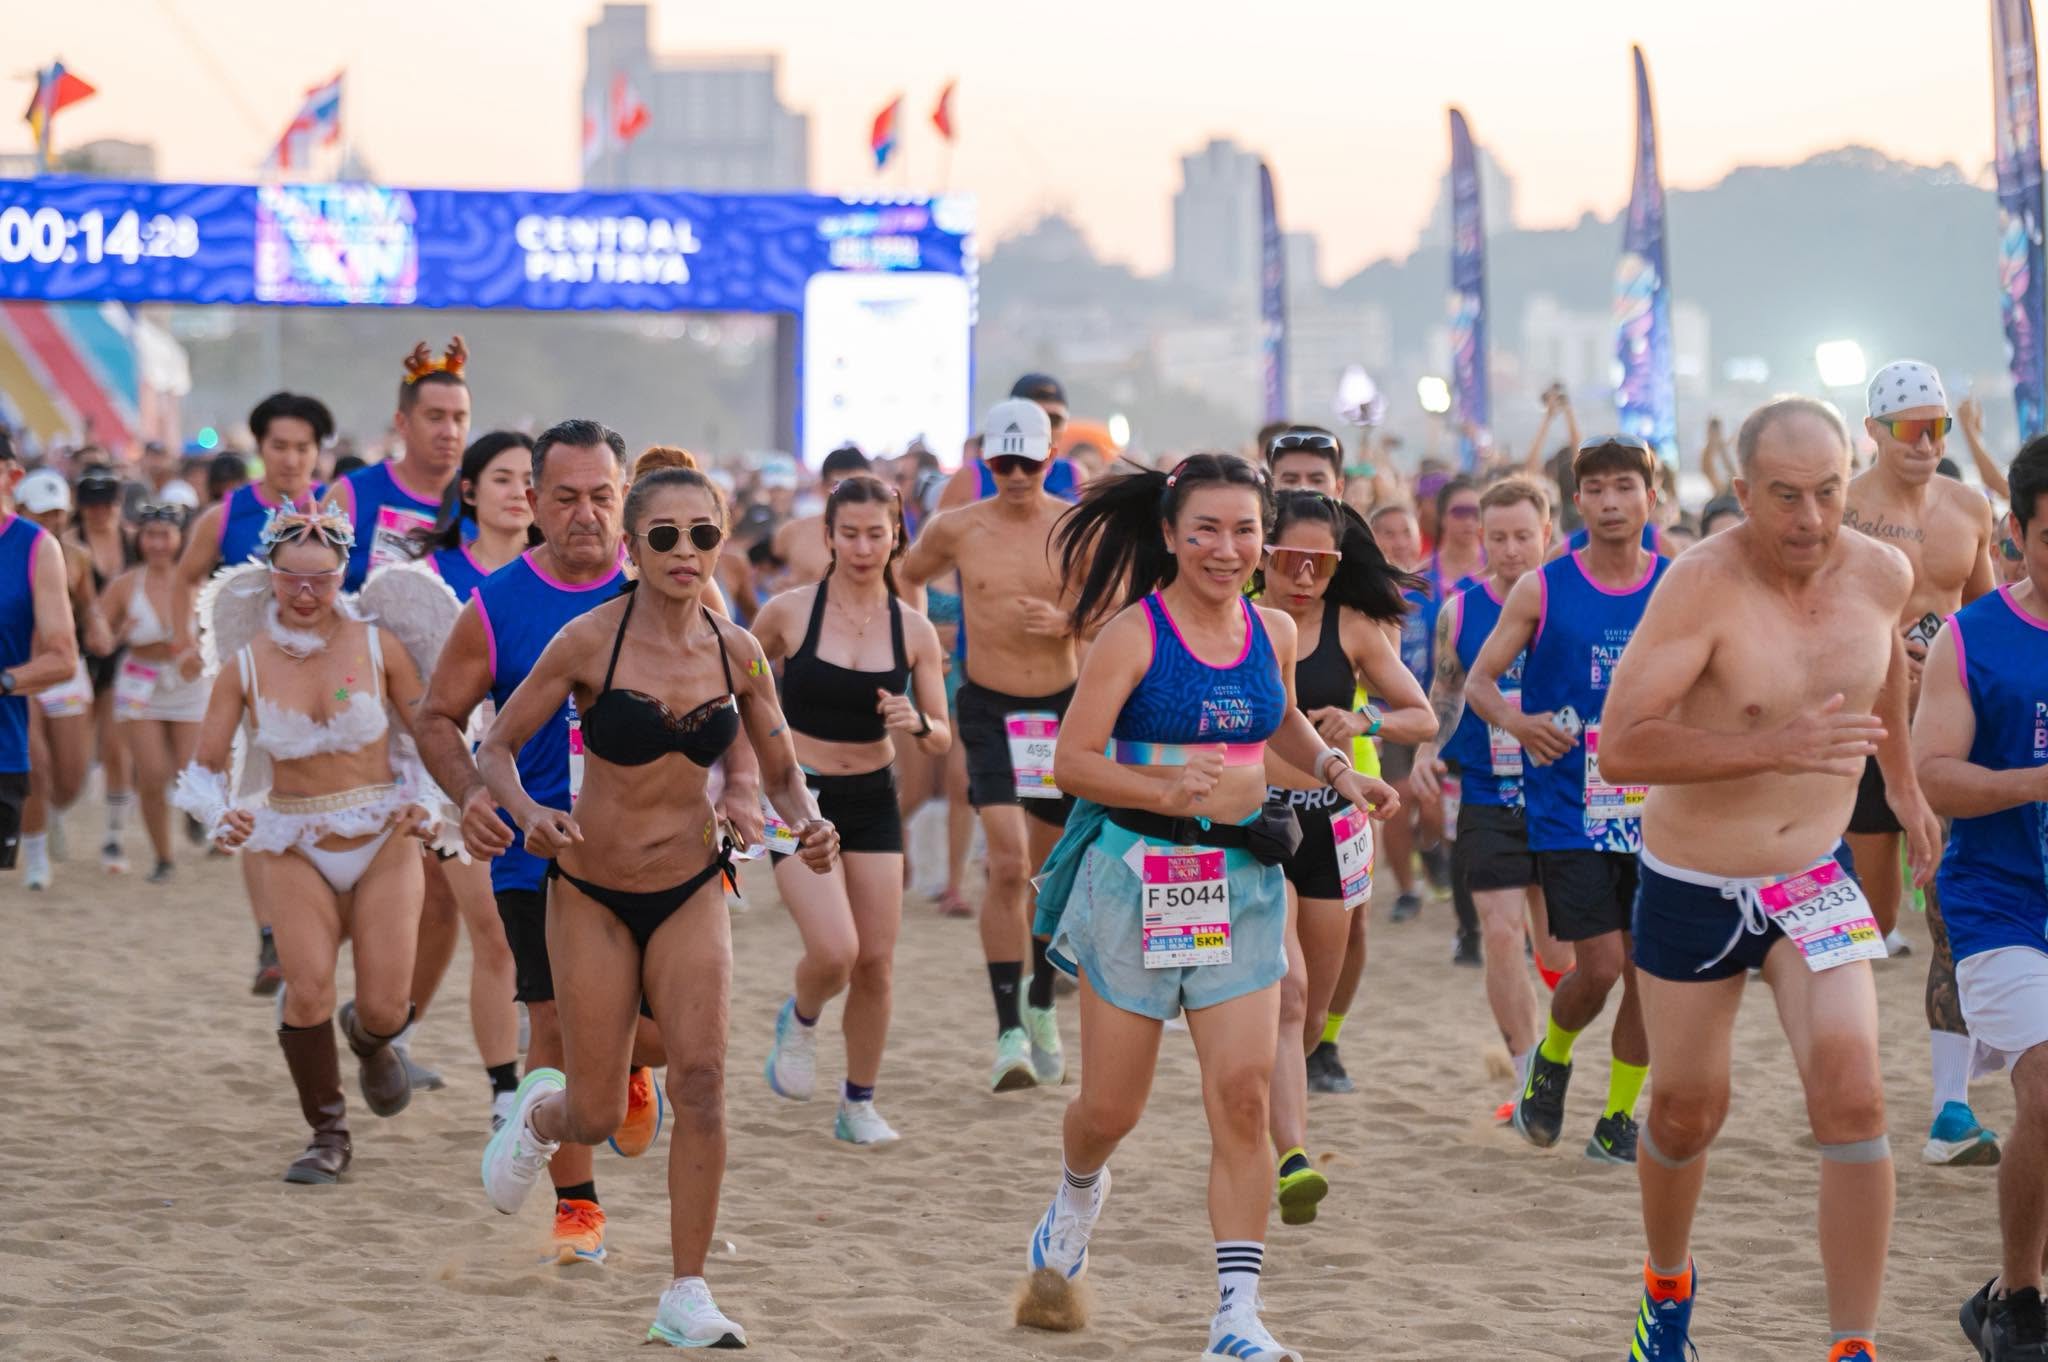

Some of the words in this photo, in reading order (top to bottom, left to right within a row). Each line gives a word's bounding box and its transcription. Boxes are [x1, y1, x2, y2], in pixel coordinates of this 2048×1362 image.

[515, 213, 702, 256] CENTRAL
[524, 251, 690, 286] PATTAYA
[1201, 698, 1254, 712] PATTAYA
[1288, 785, 1339, 811] PRO
[1342, 852, 1351, 865] F
[1148, 888, 1160, 909] F
[1166, 884, 1226, 908] 5044
[1775, 909, 1800, 927] M
[1798, 886, 1858, 917] 5233
[1196, 935, 1224, 947] 5KM
